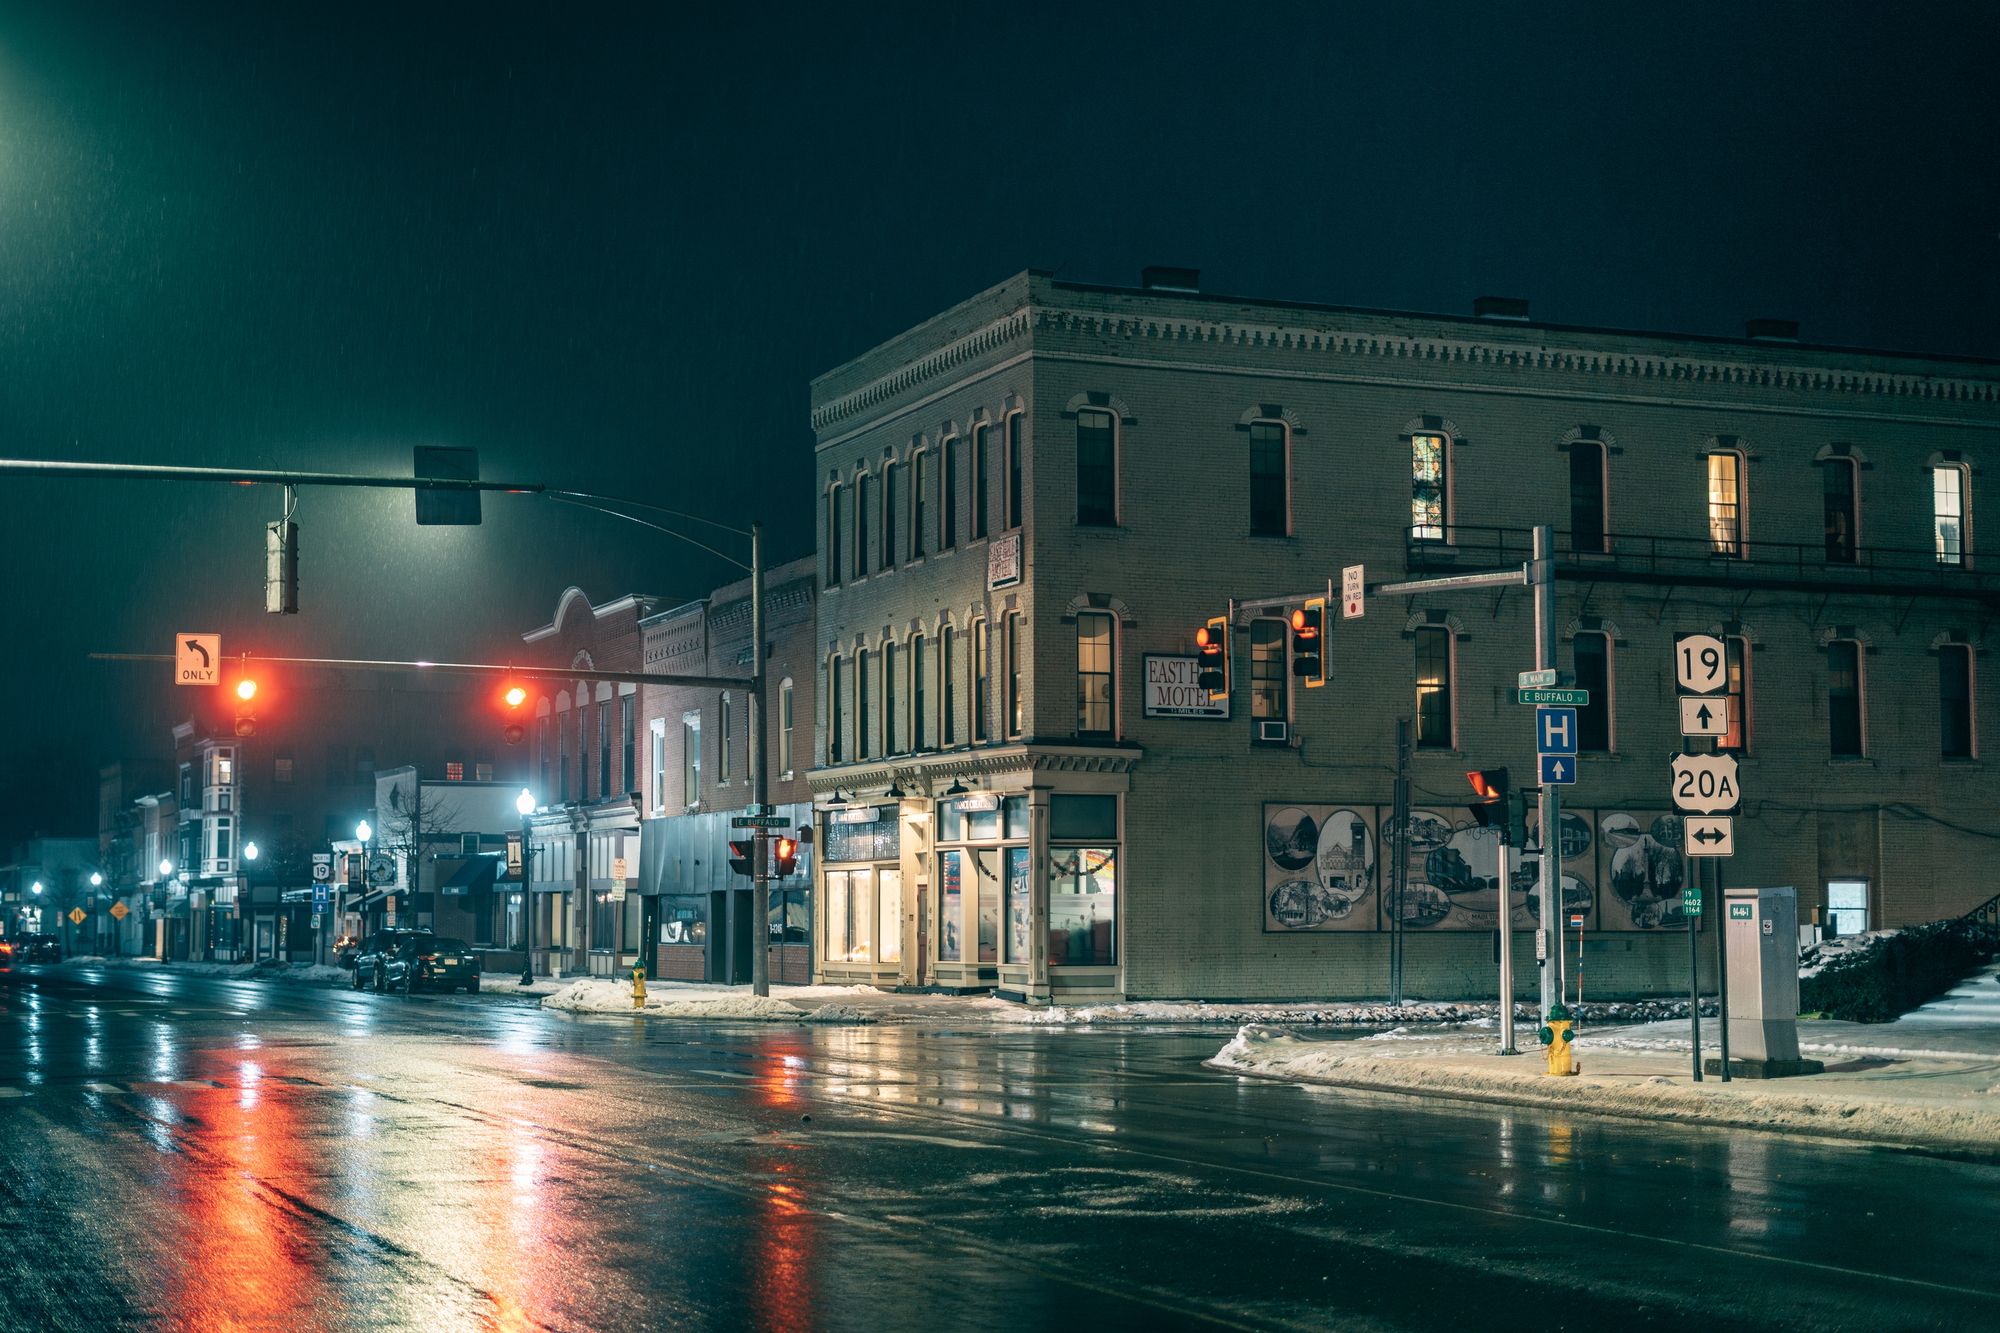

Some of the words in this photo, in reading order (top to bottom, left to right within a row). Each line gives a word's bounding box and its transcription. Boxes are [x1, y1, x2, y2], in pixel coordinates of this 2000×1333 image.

[1348, 571, 1357, 581] NO
[1347, 583, 1359, 591] TURN
[1353, 592, 1361, 600] RED
[1683, 648, 1719, 681] 19
[183, 670, 213, 680] ONLY
[1148, 660, 1186, 684] EAST
[1530, 673, 1544, 683] MAIN
[1157, 686, 1216, 707] MOTEL
[1524, 692, 1530, 701] E
[1534, 692, 1573, 702] BUFFALO
[1545, 714, 1569, 747] H
[1678, 769, 1733, 798] 20A
[738, 818, 743, 826] E
[747, 818, 780, 826] BUFFALO
[316, 866, 326, 877] 19
[315, 887, 326, 900] H
